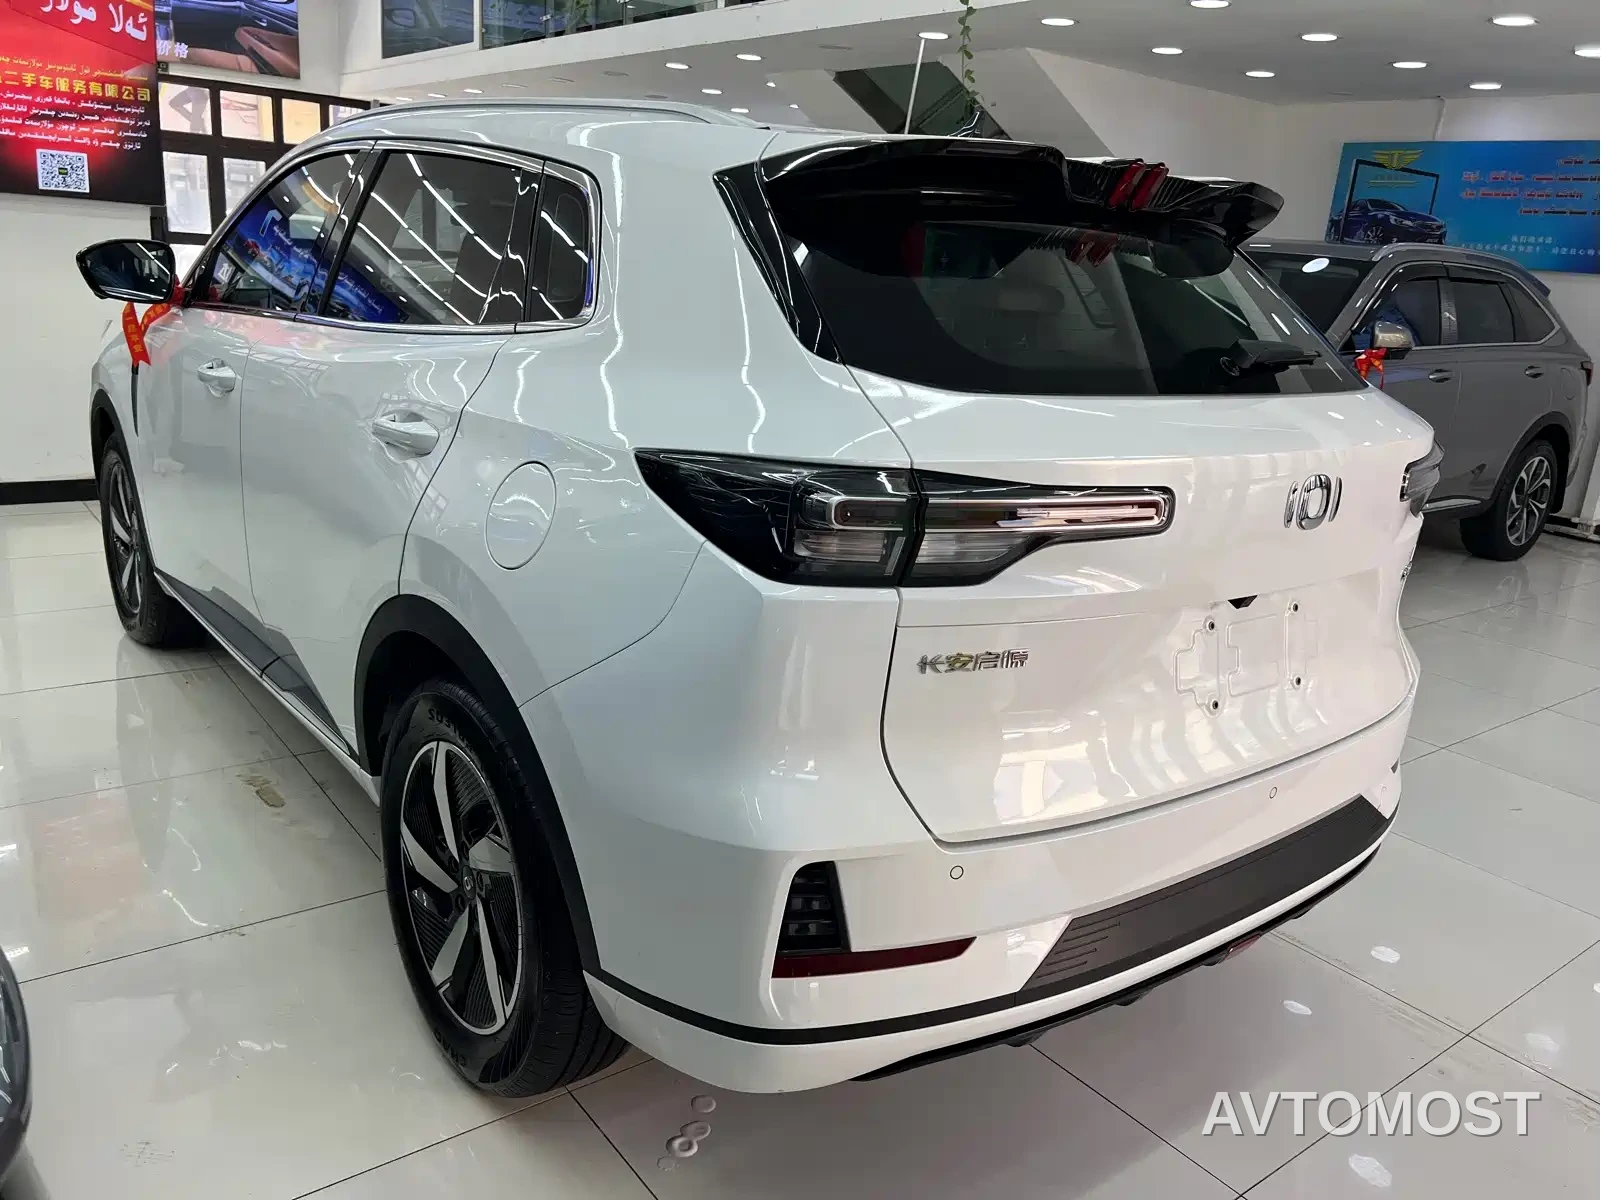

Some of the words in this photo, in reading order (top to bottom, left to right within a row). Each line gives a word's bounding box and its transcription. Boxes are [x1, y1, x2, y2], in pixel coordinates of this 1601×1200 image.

[0, 70, 151, 102] 二手车服务有限公司
[916, 648, 1030, 675] 长安启源
